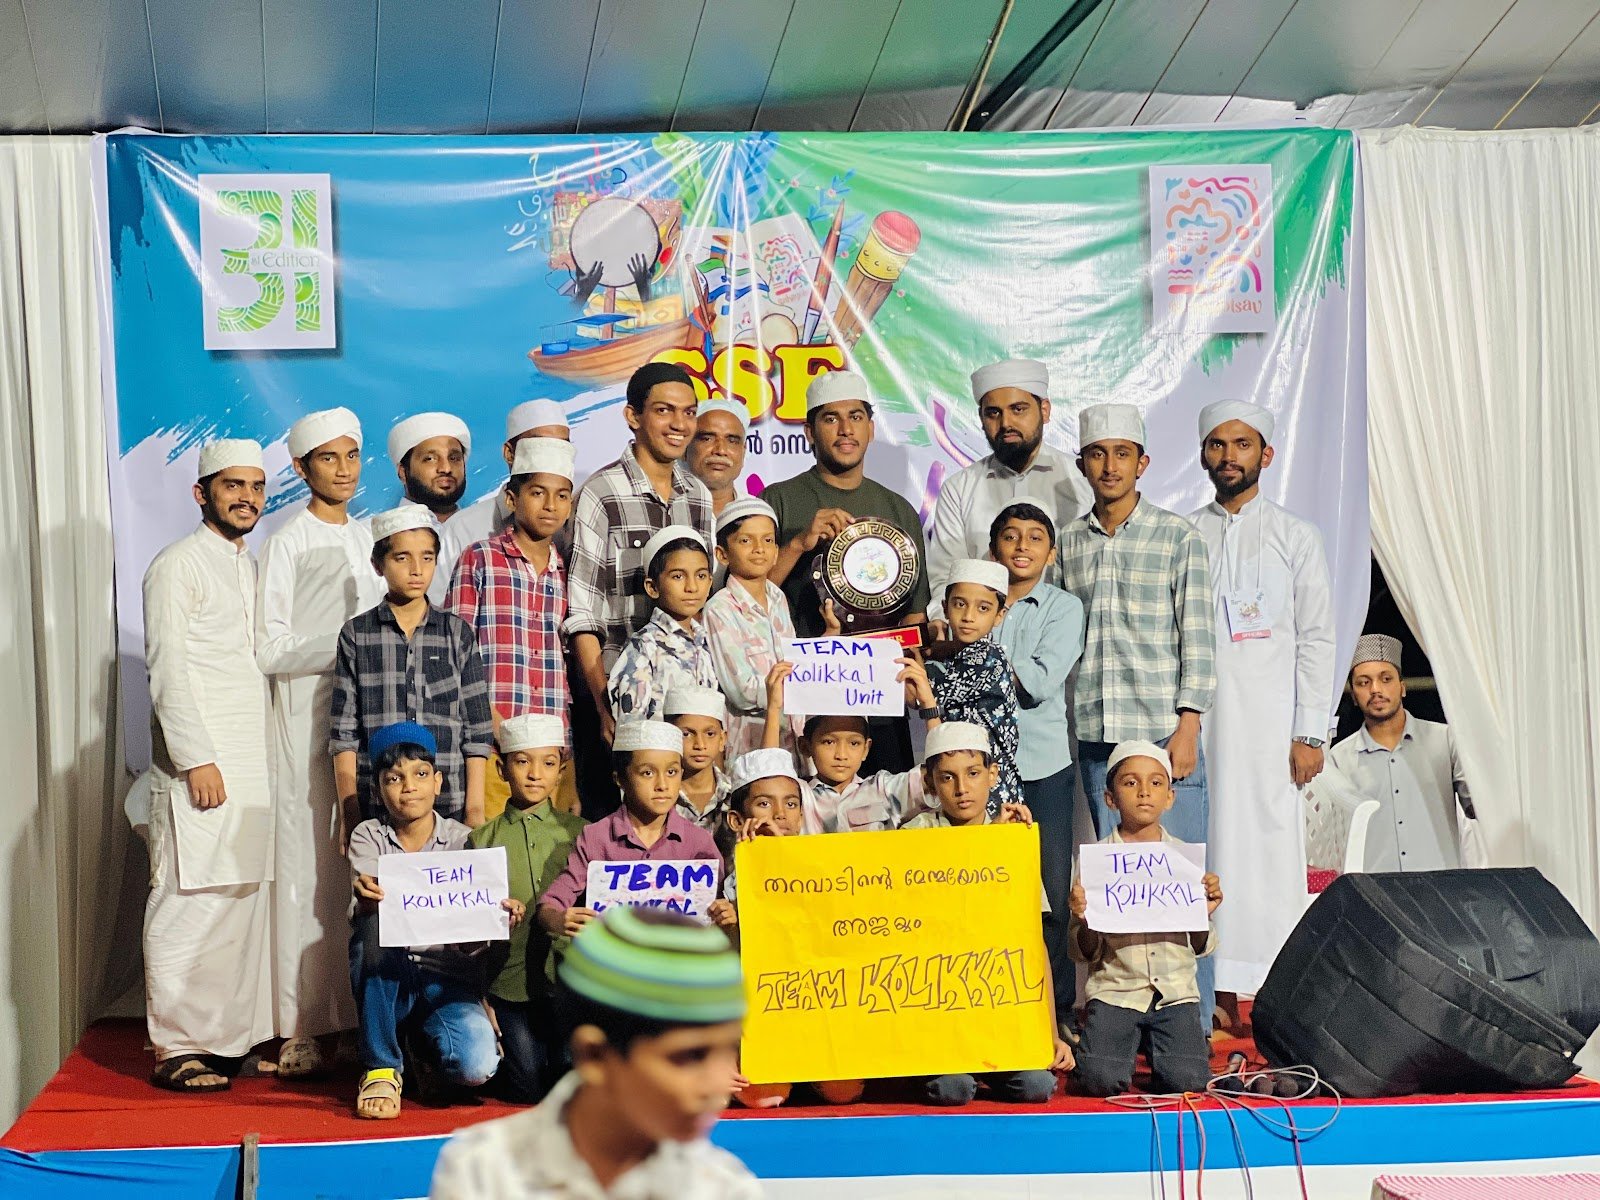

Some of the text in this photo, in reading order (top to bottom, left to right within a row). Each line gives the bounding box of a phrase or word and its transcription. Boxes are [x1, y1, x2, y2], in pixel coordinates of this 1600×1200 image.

[262, 251, 319, 268] Edition
[792, 640, 873, 657] TEAM
[846, 687, 885, 706] Unit
[421, 863, 473, 886] TEAM
[1105, 852, 1173, 878] TEAM
[604, 863, 714, 892] TEAM
[402, 887, 497, 911] KOLIKKAL
[1105, 876, 1204, 913] KOLIKKAL
[757, 947, 1045, 1015] TEAM KOLIKKAL
